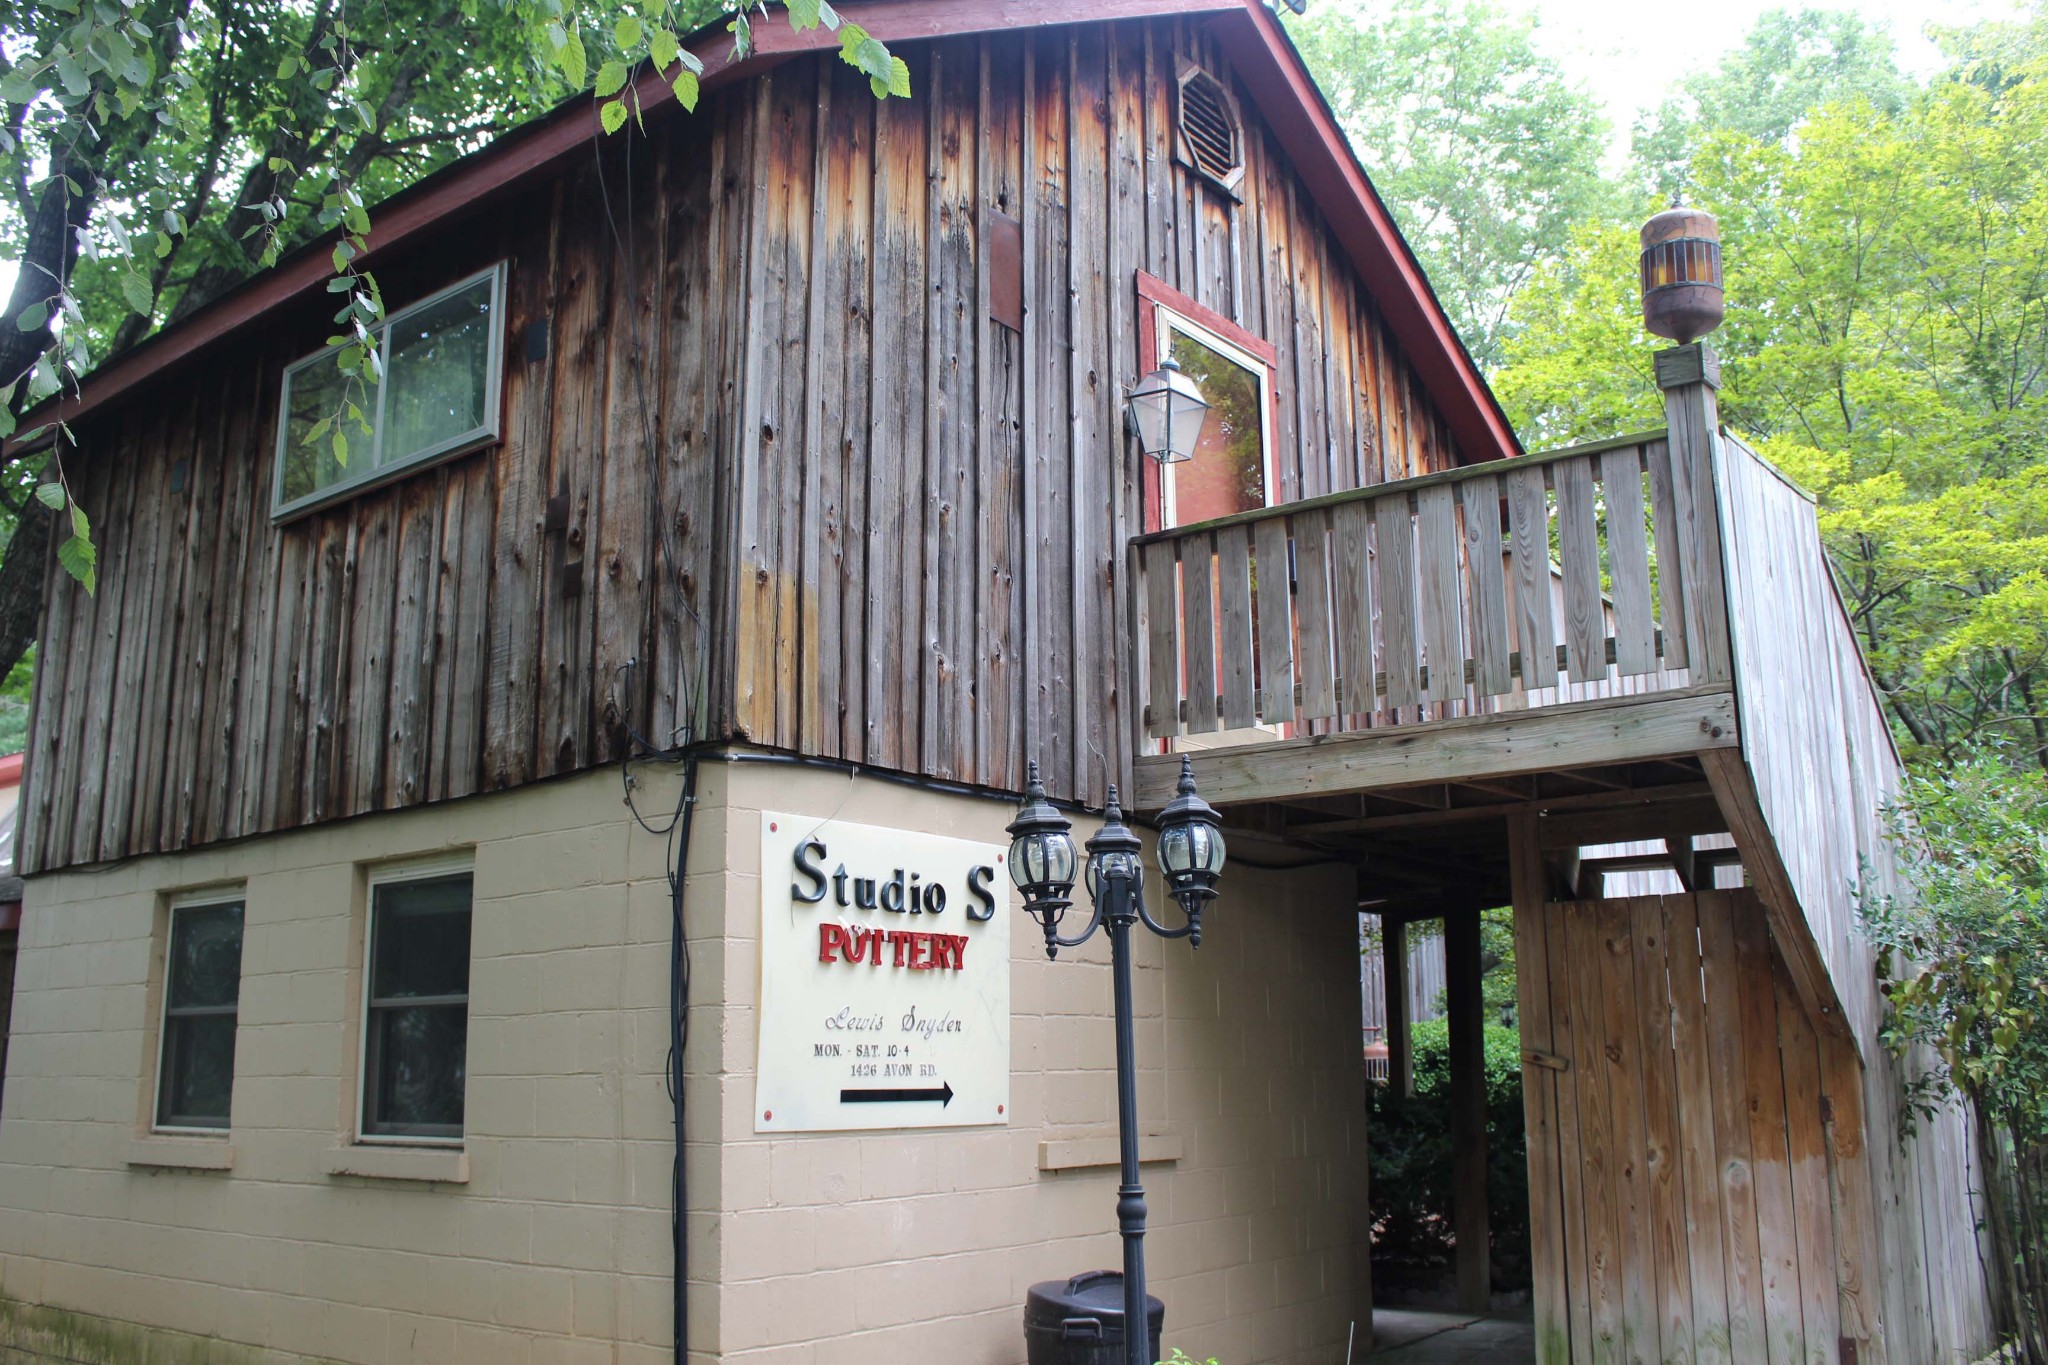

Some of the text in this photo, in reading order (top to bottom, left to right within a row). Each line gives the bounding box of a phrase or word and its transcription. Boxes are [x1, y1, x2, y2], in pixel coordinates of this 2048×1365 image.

[791, 839, 995, 921] Studio S
[819, 923, 969, 970] POTTERY
[825, 1006, 884, 1031] Lewis
[814, 1043, 842, 1058] MON.
[856, 1044, 881, 1058] SAT.
[887, 1044, 909, 1058] 10-4
[850, 1063, 937, 1078] 1426 AVON RD.
